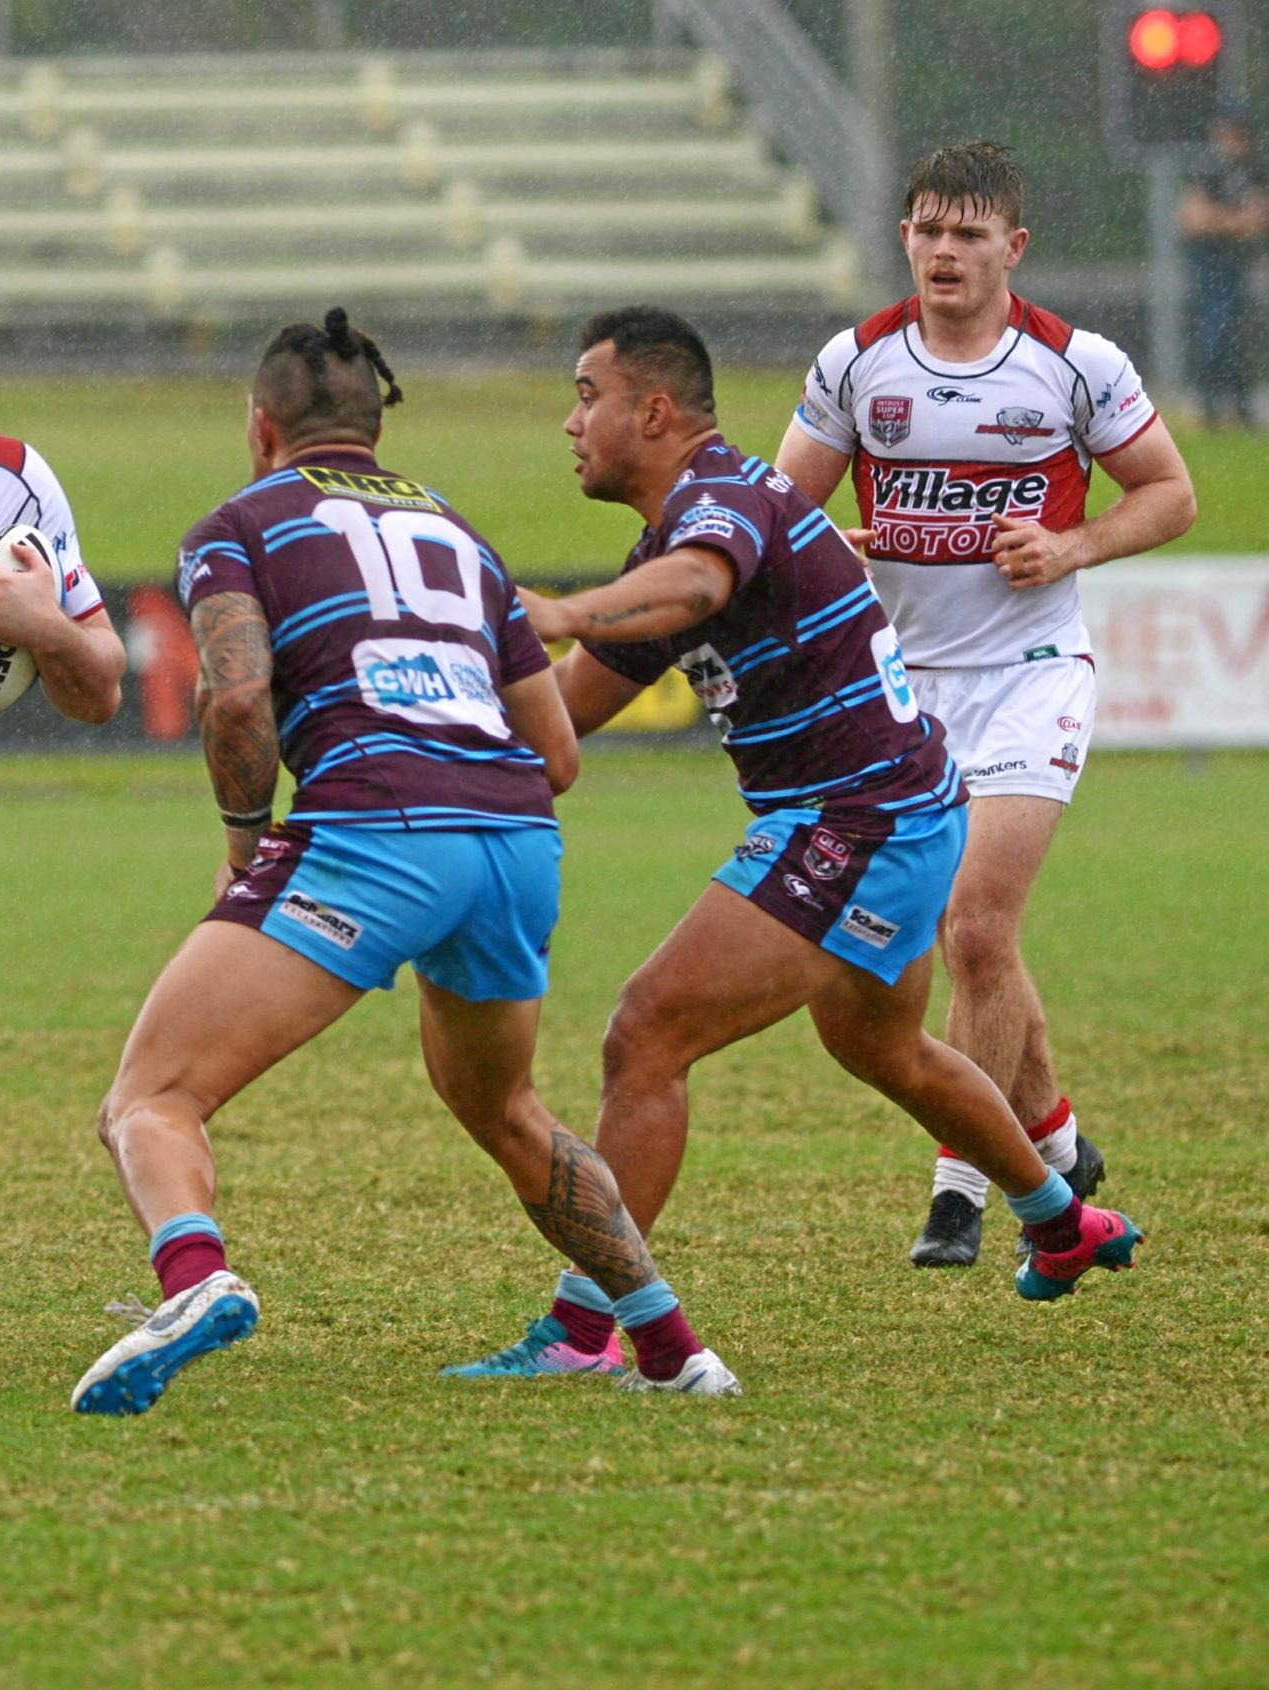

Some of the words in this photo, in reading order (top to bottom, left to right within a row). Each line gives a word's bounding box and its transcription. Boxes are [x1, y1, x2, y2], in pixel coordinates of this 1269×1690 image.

[871, 464, 1049, 523] Village
[870, 520, 1000, 556] MOTO
[312, 499, 484, 631] 10
[374, 668, 448, 697] CWH
[818, 835, 846, 854] QLD
